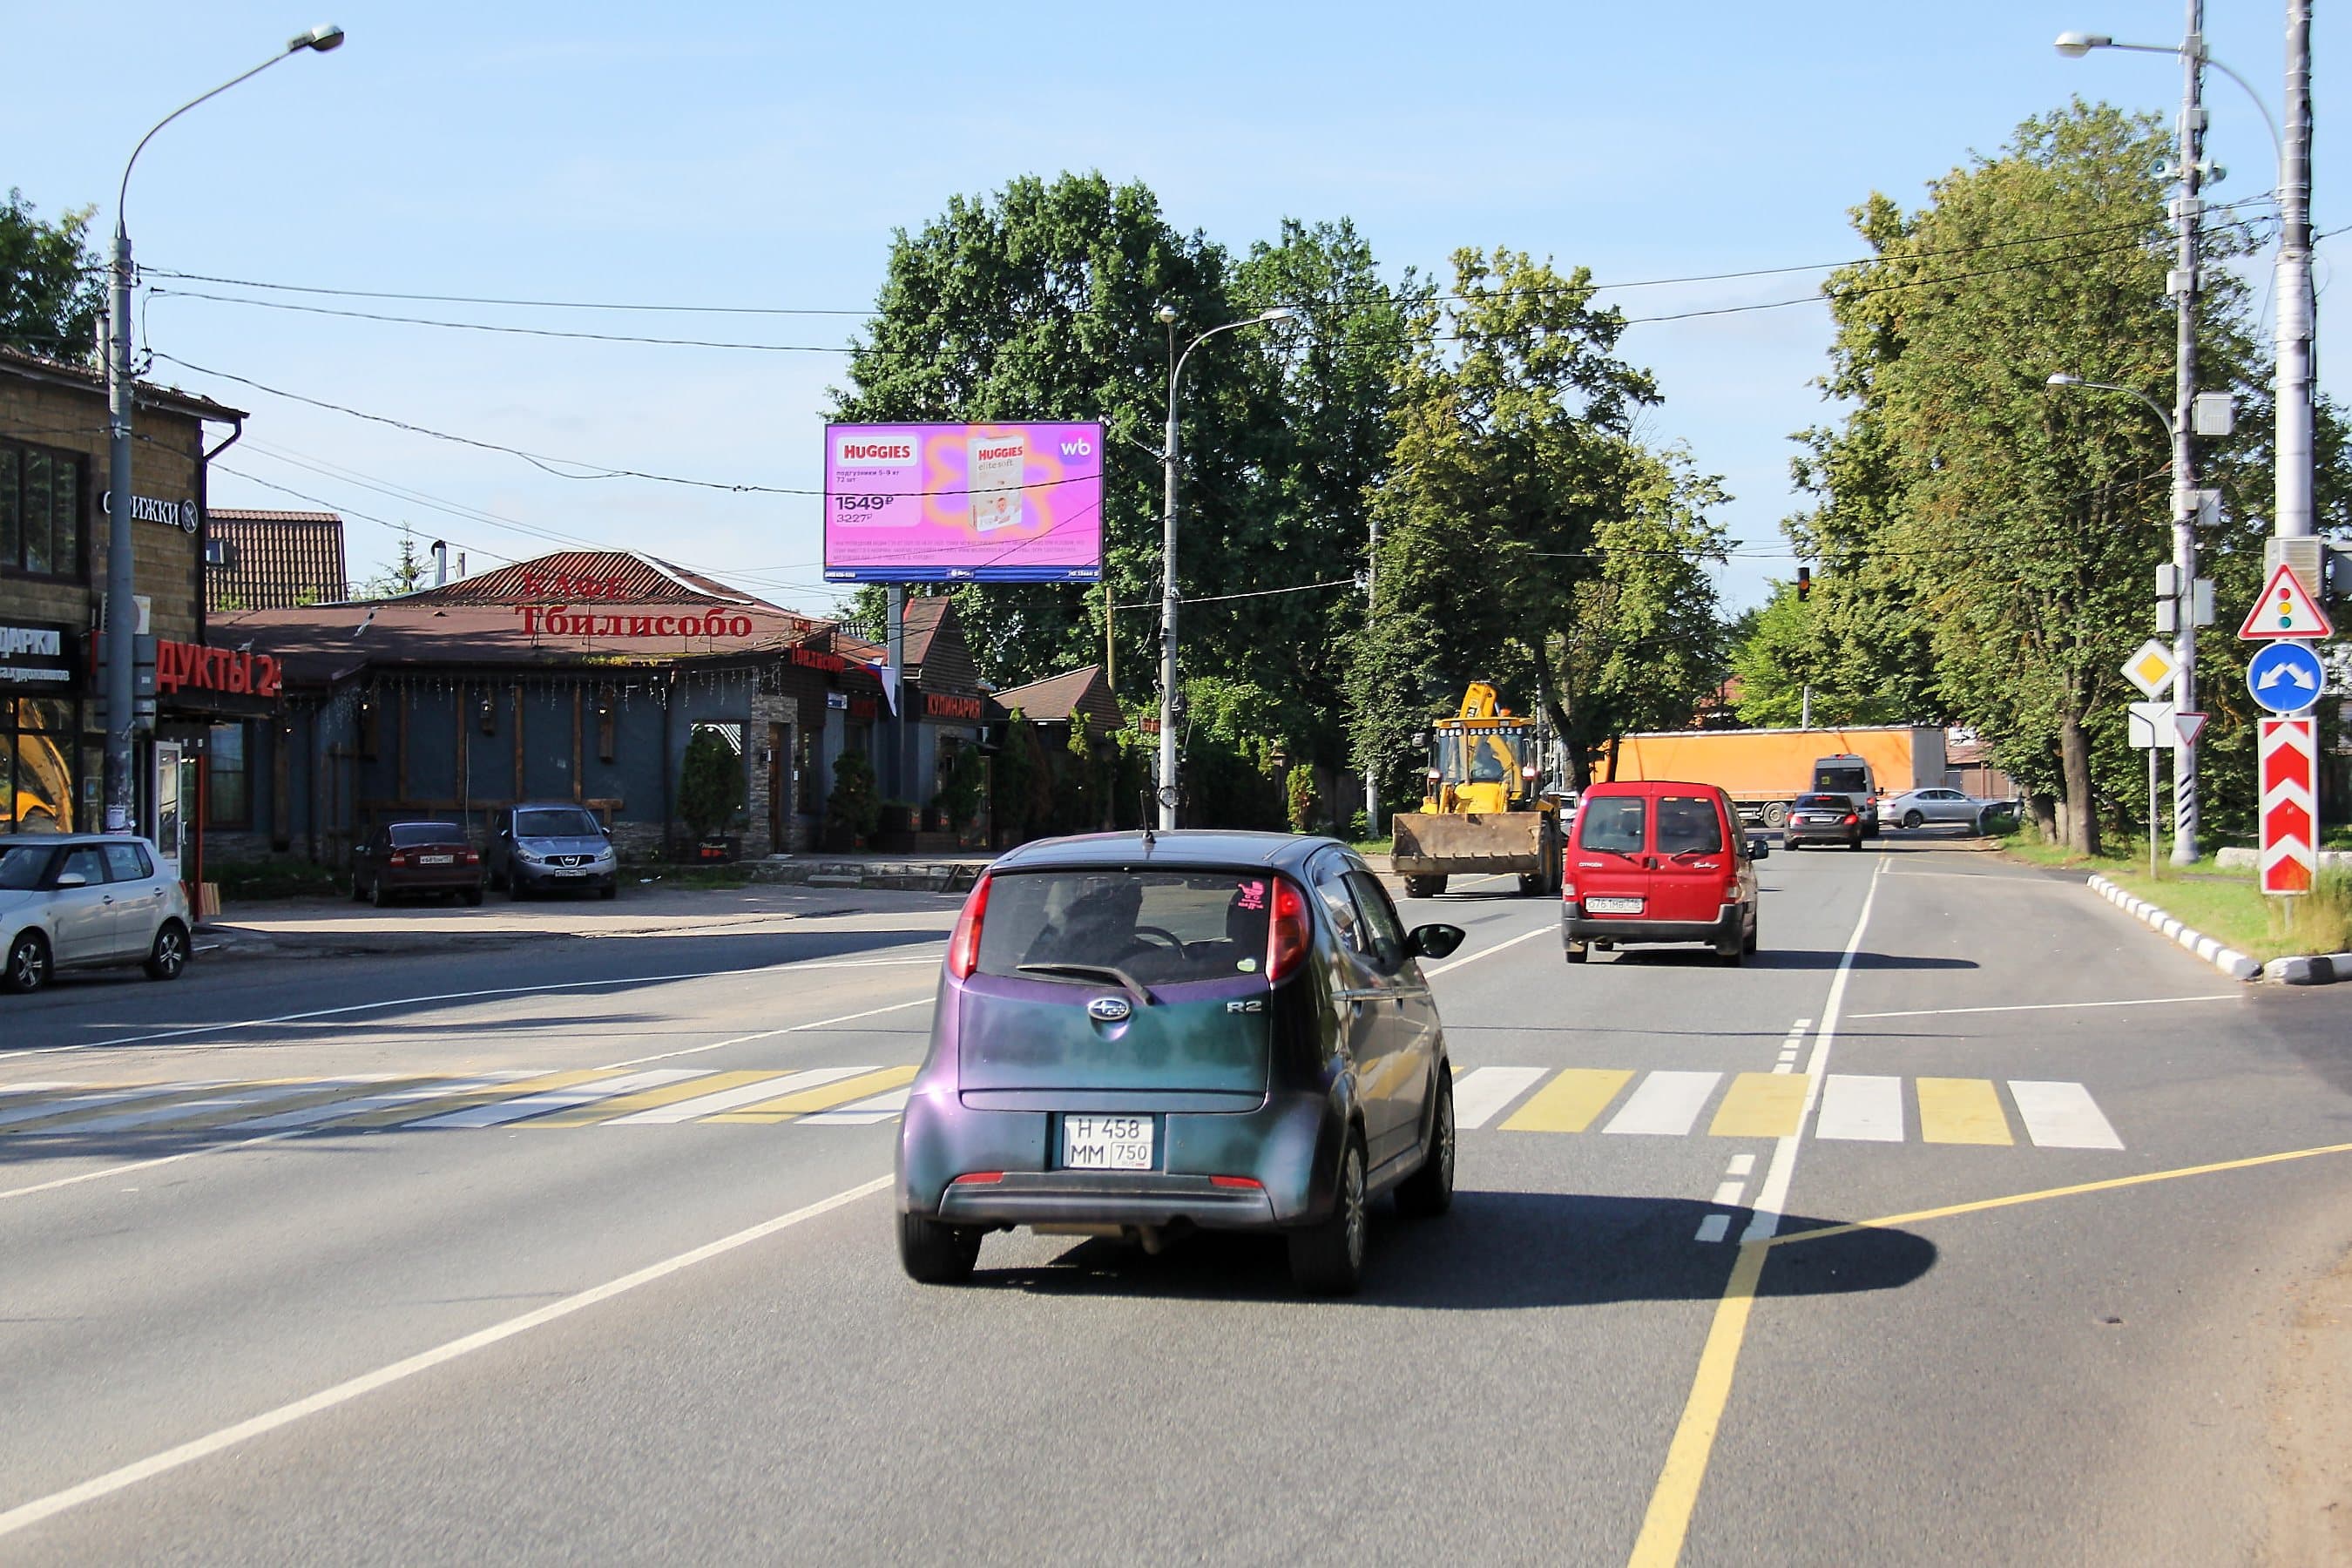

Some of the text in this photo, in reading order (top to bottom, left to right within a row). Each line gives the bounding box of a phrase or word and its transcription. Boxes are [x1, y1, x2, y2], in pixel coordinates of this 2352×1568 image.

[843, 444, 910, 459] HUGGIES
[978, 445, 1024, 461] HUGGIES
[1060, 438, 1091, 456] wb
[103, 490, 180, 526] СИЖКИ
[522, 572, 627, 599] КАФЕ
[515, 605, 753, 638] Тбилисобо
[928, 693, 981, 720] КУЛИНАРИЯ
[1227, 1001, 1262, 1013] R2
[1101, 1119, 1139, 1139] 458
[1115, 1145, 1147, 1160] 750
